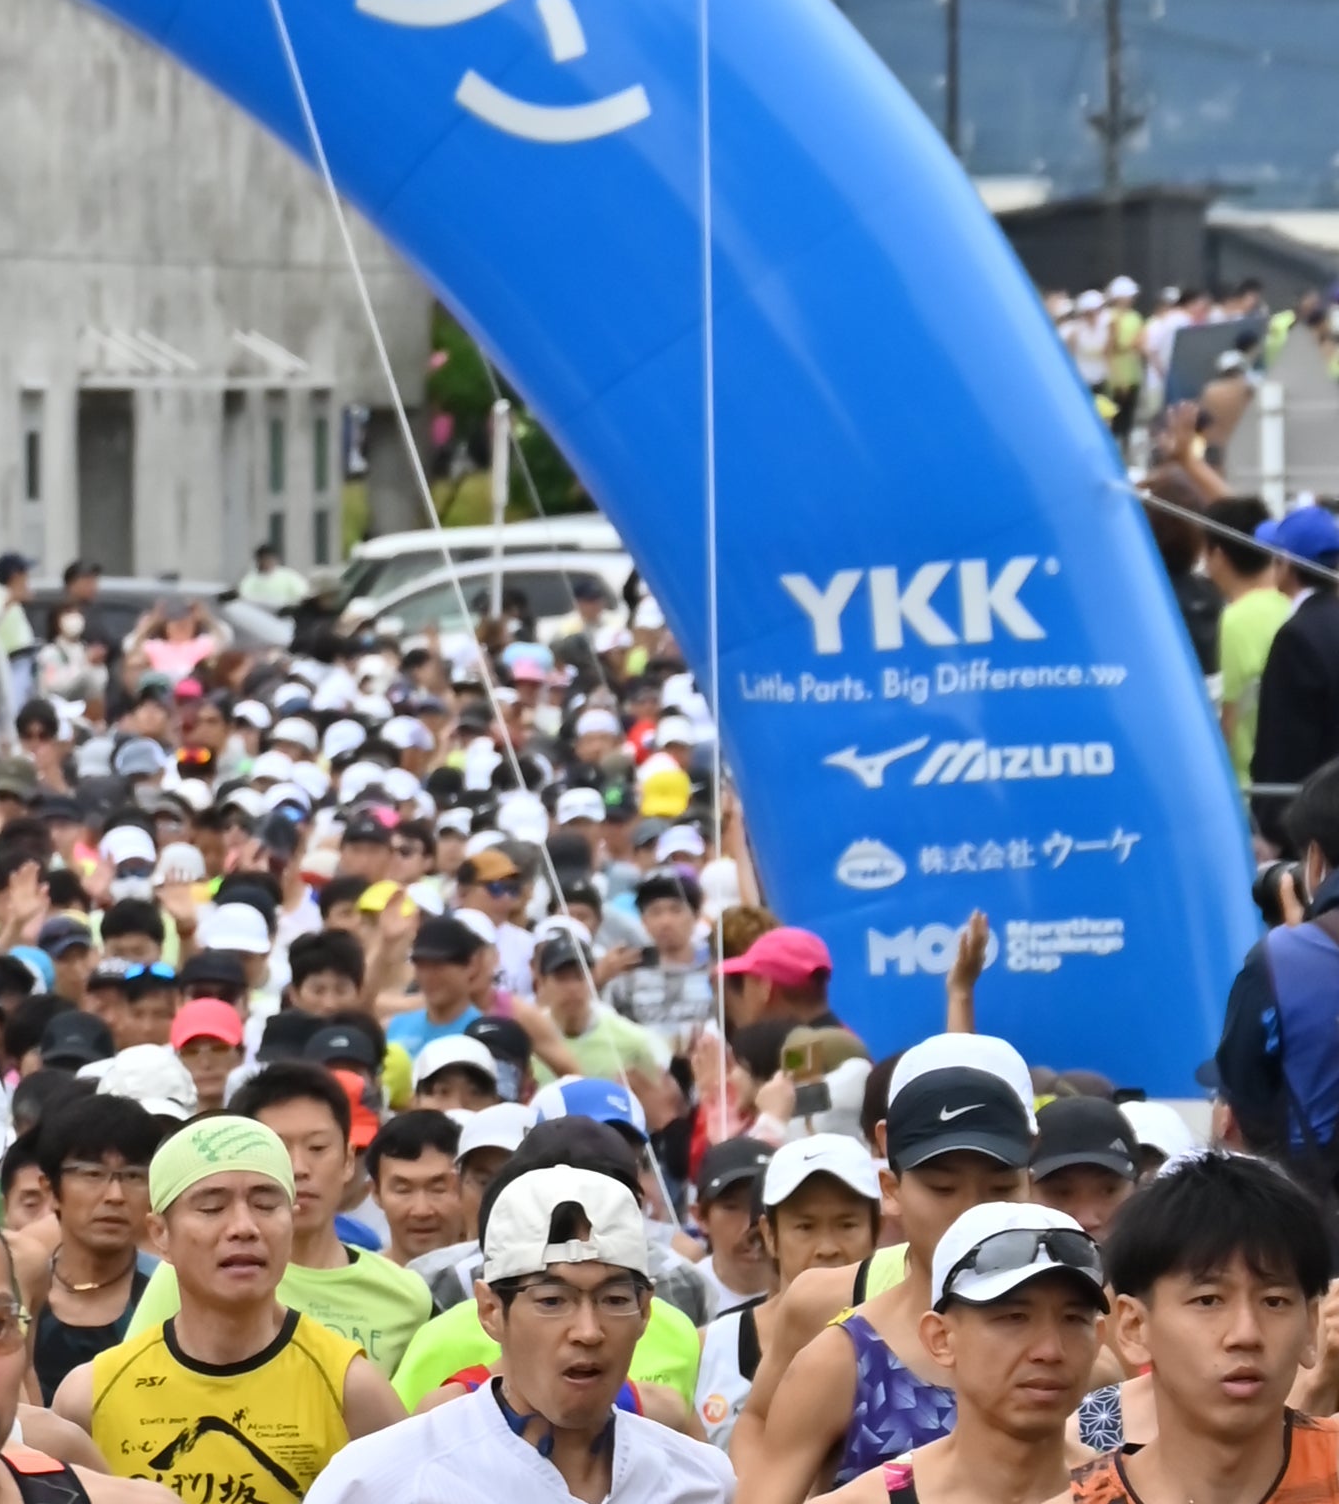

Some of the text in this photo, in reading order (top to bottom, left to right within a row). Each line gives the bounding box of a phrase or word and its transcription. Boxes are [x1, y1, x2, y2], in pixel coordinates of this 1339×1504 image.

[779, 555, 1048, 656] YKK
[739, 658, 1091, 706] Little Parts. Big Difference.
